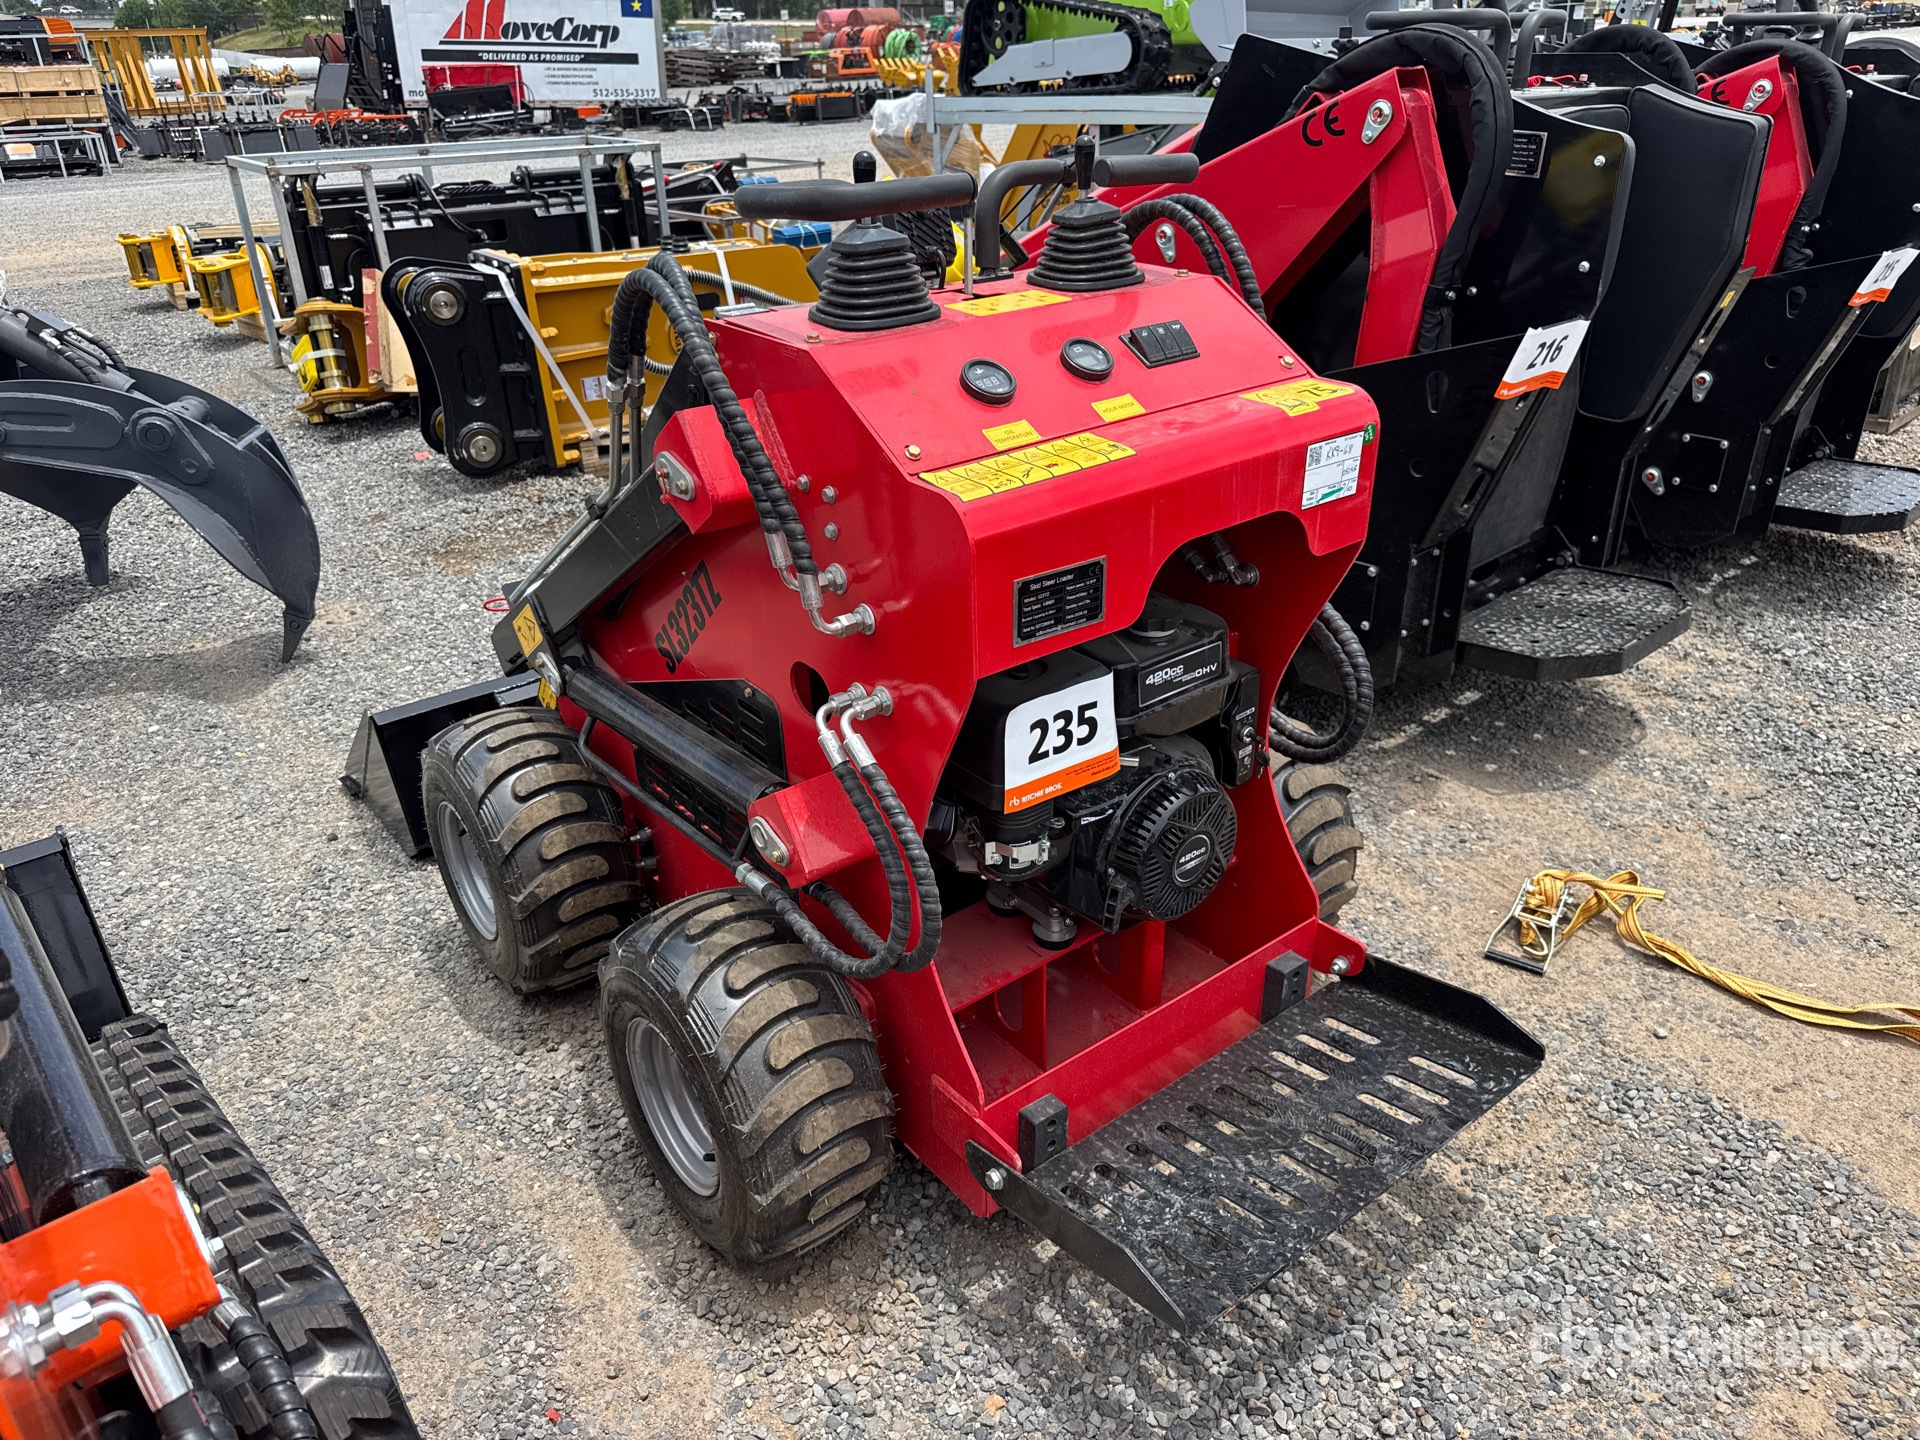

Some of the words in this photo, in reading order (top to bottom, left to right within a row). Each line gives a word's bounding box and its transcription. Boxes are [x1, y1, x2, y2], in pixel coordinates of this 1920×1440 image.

[528, 53, 540, 61] AS
[1301, 100, 1346, 147] CE
[1872, 258, 1901, 284] 215
[1526, 334, 1569, 371] 216
[1101, 405, 1116, 414] HOUR
[1117, 401, 1135, 411] METER
[994, 430, 1034, 444] TEMPERATURE
[1030, 581, 1041, 591] Skid
[1042, 579, 1056, 588] Steer
[1057, 574, 1074, 583] Loader
[655, 559, 722, 674] SL323TZ
[1145, 664, 1184, 685] 420cc
[1195, 662, 1218, 677] OHV
[1028, 700, 1098, 766] 235
[1009, 796, 1020, 807] rb
[1021, 788, 1044, 804] RITCHIE
[1179, 846, 1206, 864] 420cc
